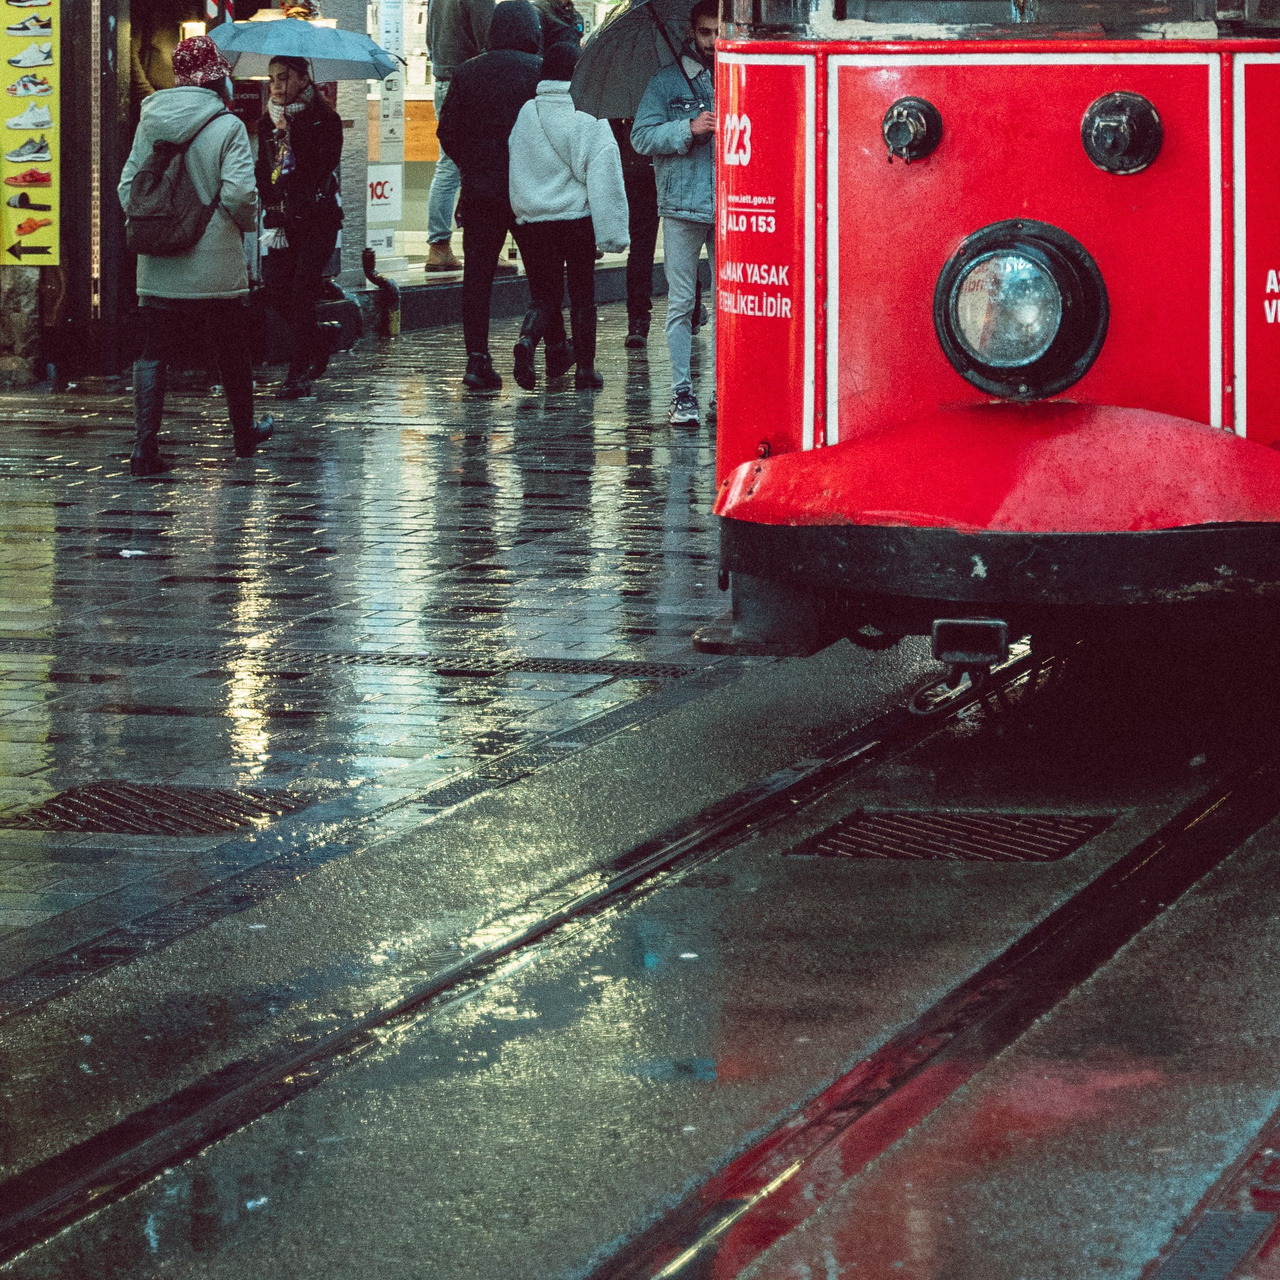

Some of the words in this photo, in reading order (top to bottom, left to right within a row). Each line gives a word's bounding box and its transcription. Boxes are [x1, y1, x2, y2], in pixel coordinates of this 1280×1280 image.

[725, 113, 751, 166] 223
[368, 180, 393, 201] 100
[728, 195, 776, 205] www.iett.gov.tr
[728, 215, 747, 232] ALO
[750, 216, 776, 233] 153
[746, 264, 790, 287] YASAK
